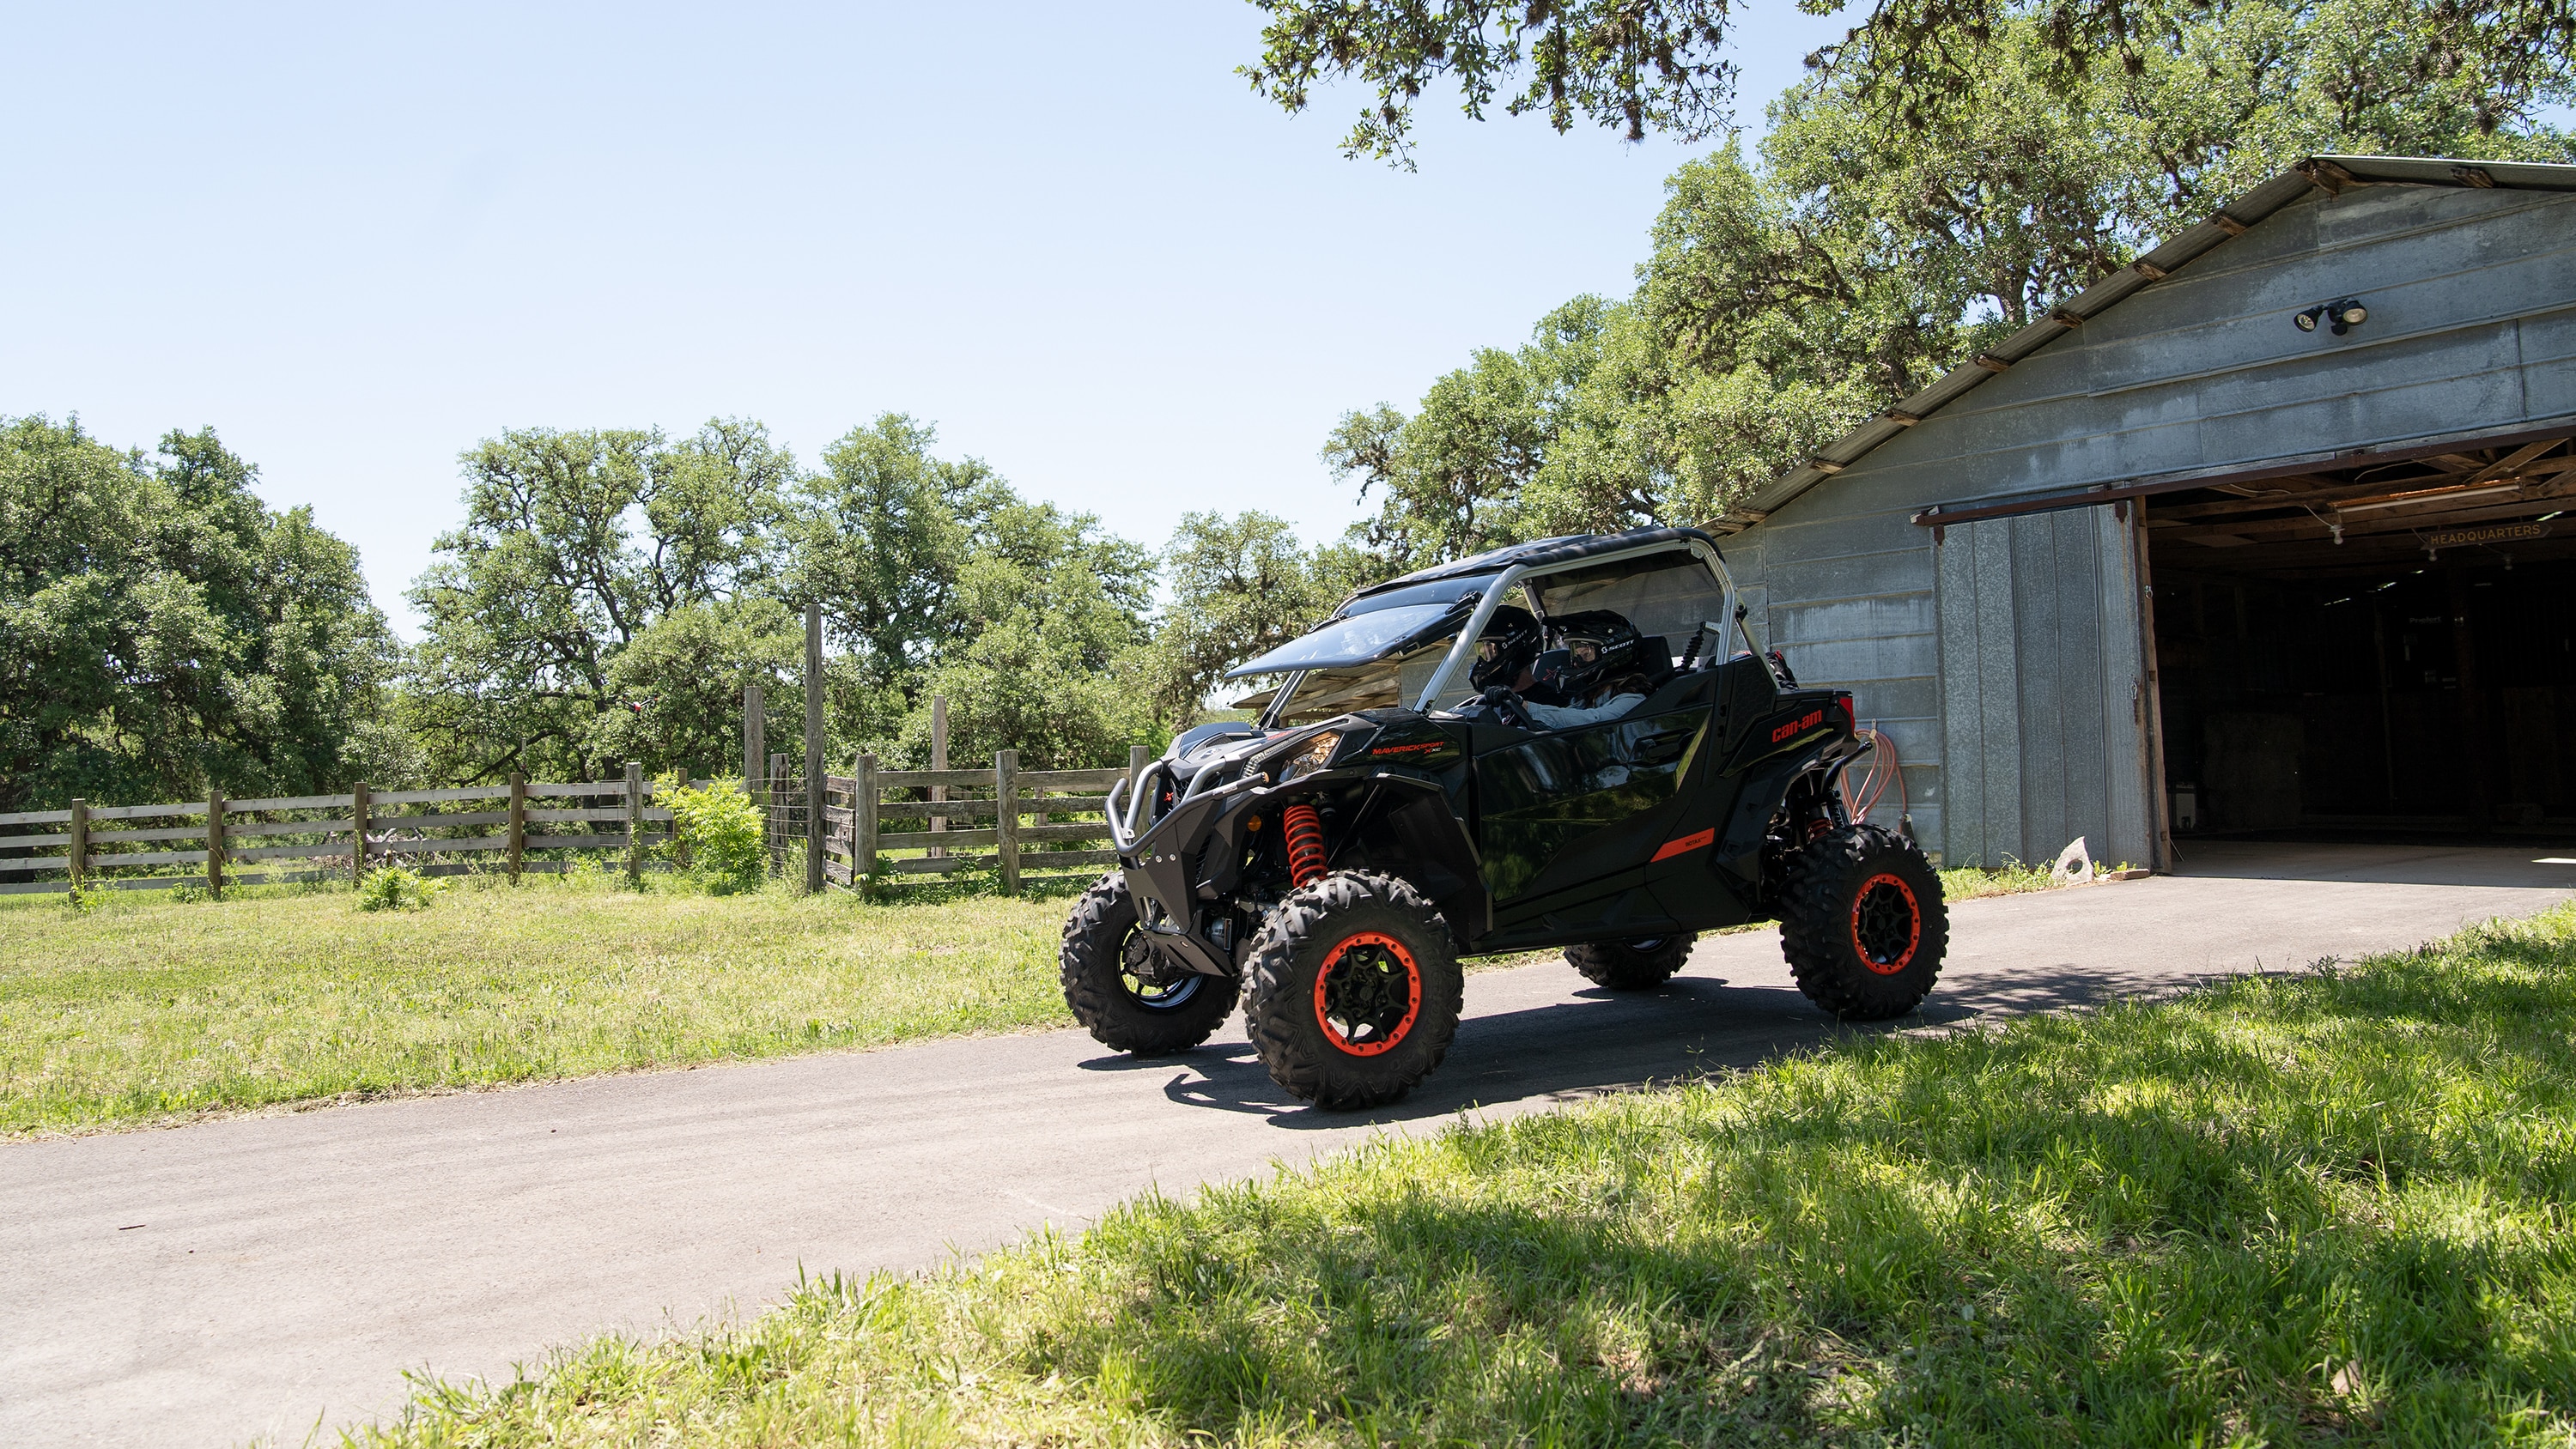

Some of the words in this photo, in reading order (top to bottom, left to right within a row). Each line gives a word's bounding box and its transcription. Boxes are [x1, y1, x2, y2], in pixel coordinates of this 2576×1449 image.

[2431, 524, 2542, 545] HEADQUARTERS
[1508, 629, 1528, 646] SCOTT
[1608, 639, 1635, 651] SCOTT
[1772, 710, 1822, 743] can-am
[1372, 744, 1420, 755] MAVERICK
